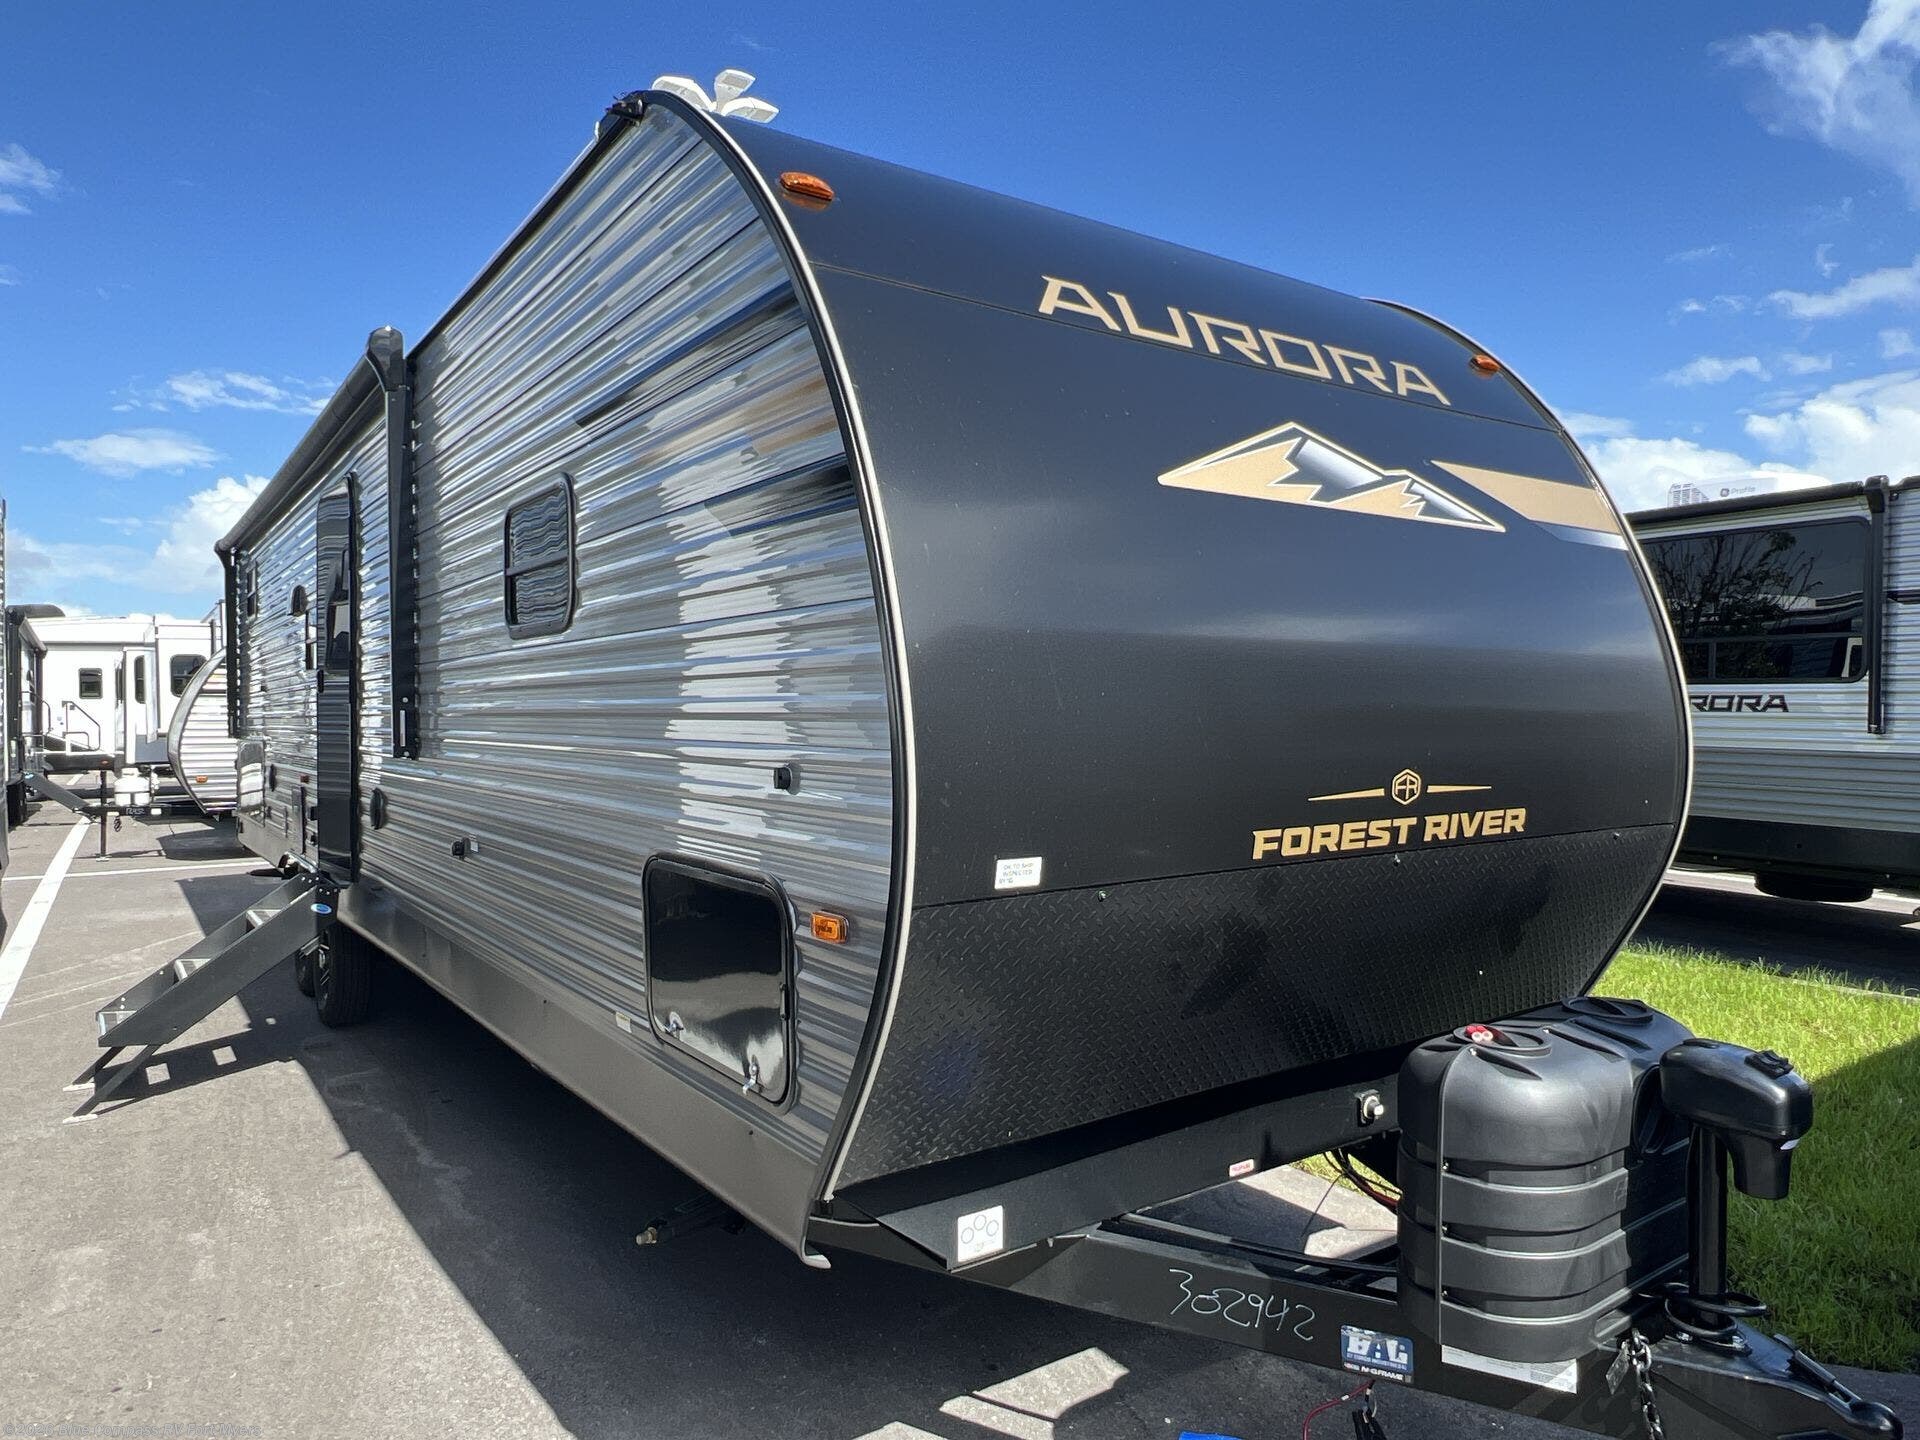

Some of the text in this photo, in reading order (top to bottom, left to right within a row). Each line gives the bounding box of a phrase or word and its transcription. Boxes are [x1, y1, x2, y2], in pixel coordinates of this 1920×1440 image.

[1038, 275, 1451, 406] AURORA
[1252, 807, 1527, 860] FOREST RIVER
[1168, 1268, 1315, 1341] 302942
